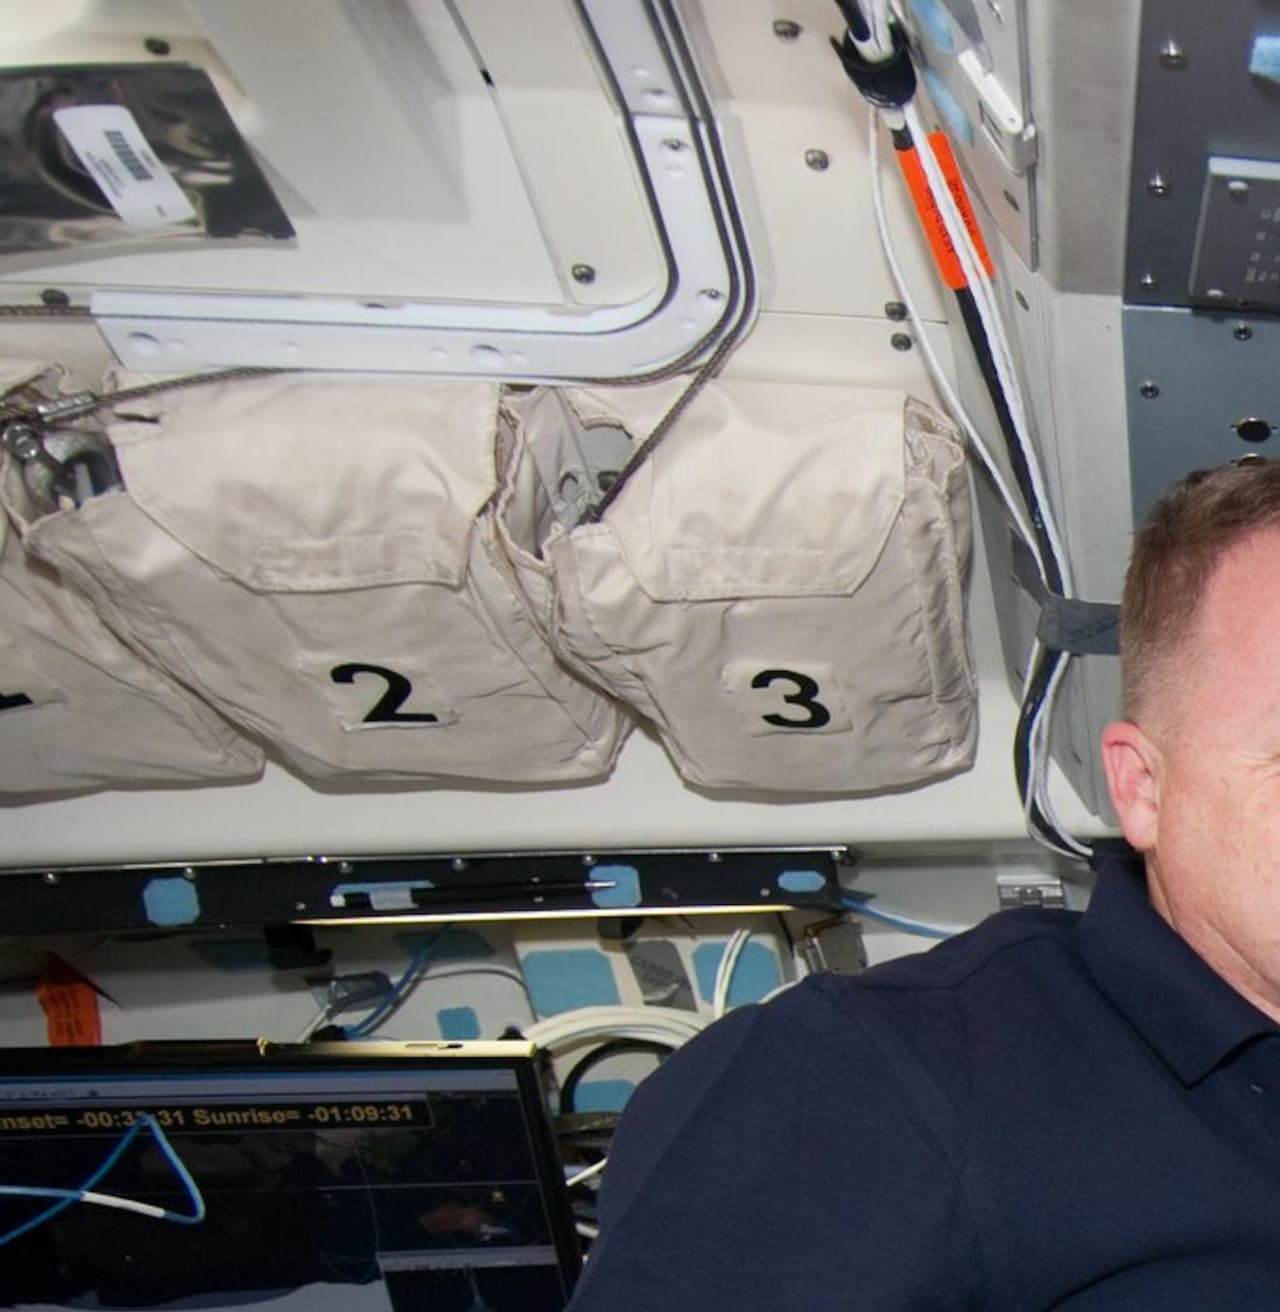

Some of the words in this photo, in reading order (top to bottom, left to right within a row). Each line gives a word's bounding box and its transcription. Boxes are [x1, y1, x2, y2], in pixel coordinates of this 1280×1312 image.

[330, 663, 439, 723] 2
[750, 669, 831, 729] 3
[192, 1108, 301, 1126] Sunrise=
[308, 1105, 413, 1123] -01:09:31
